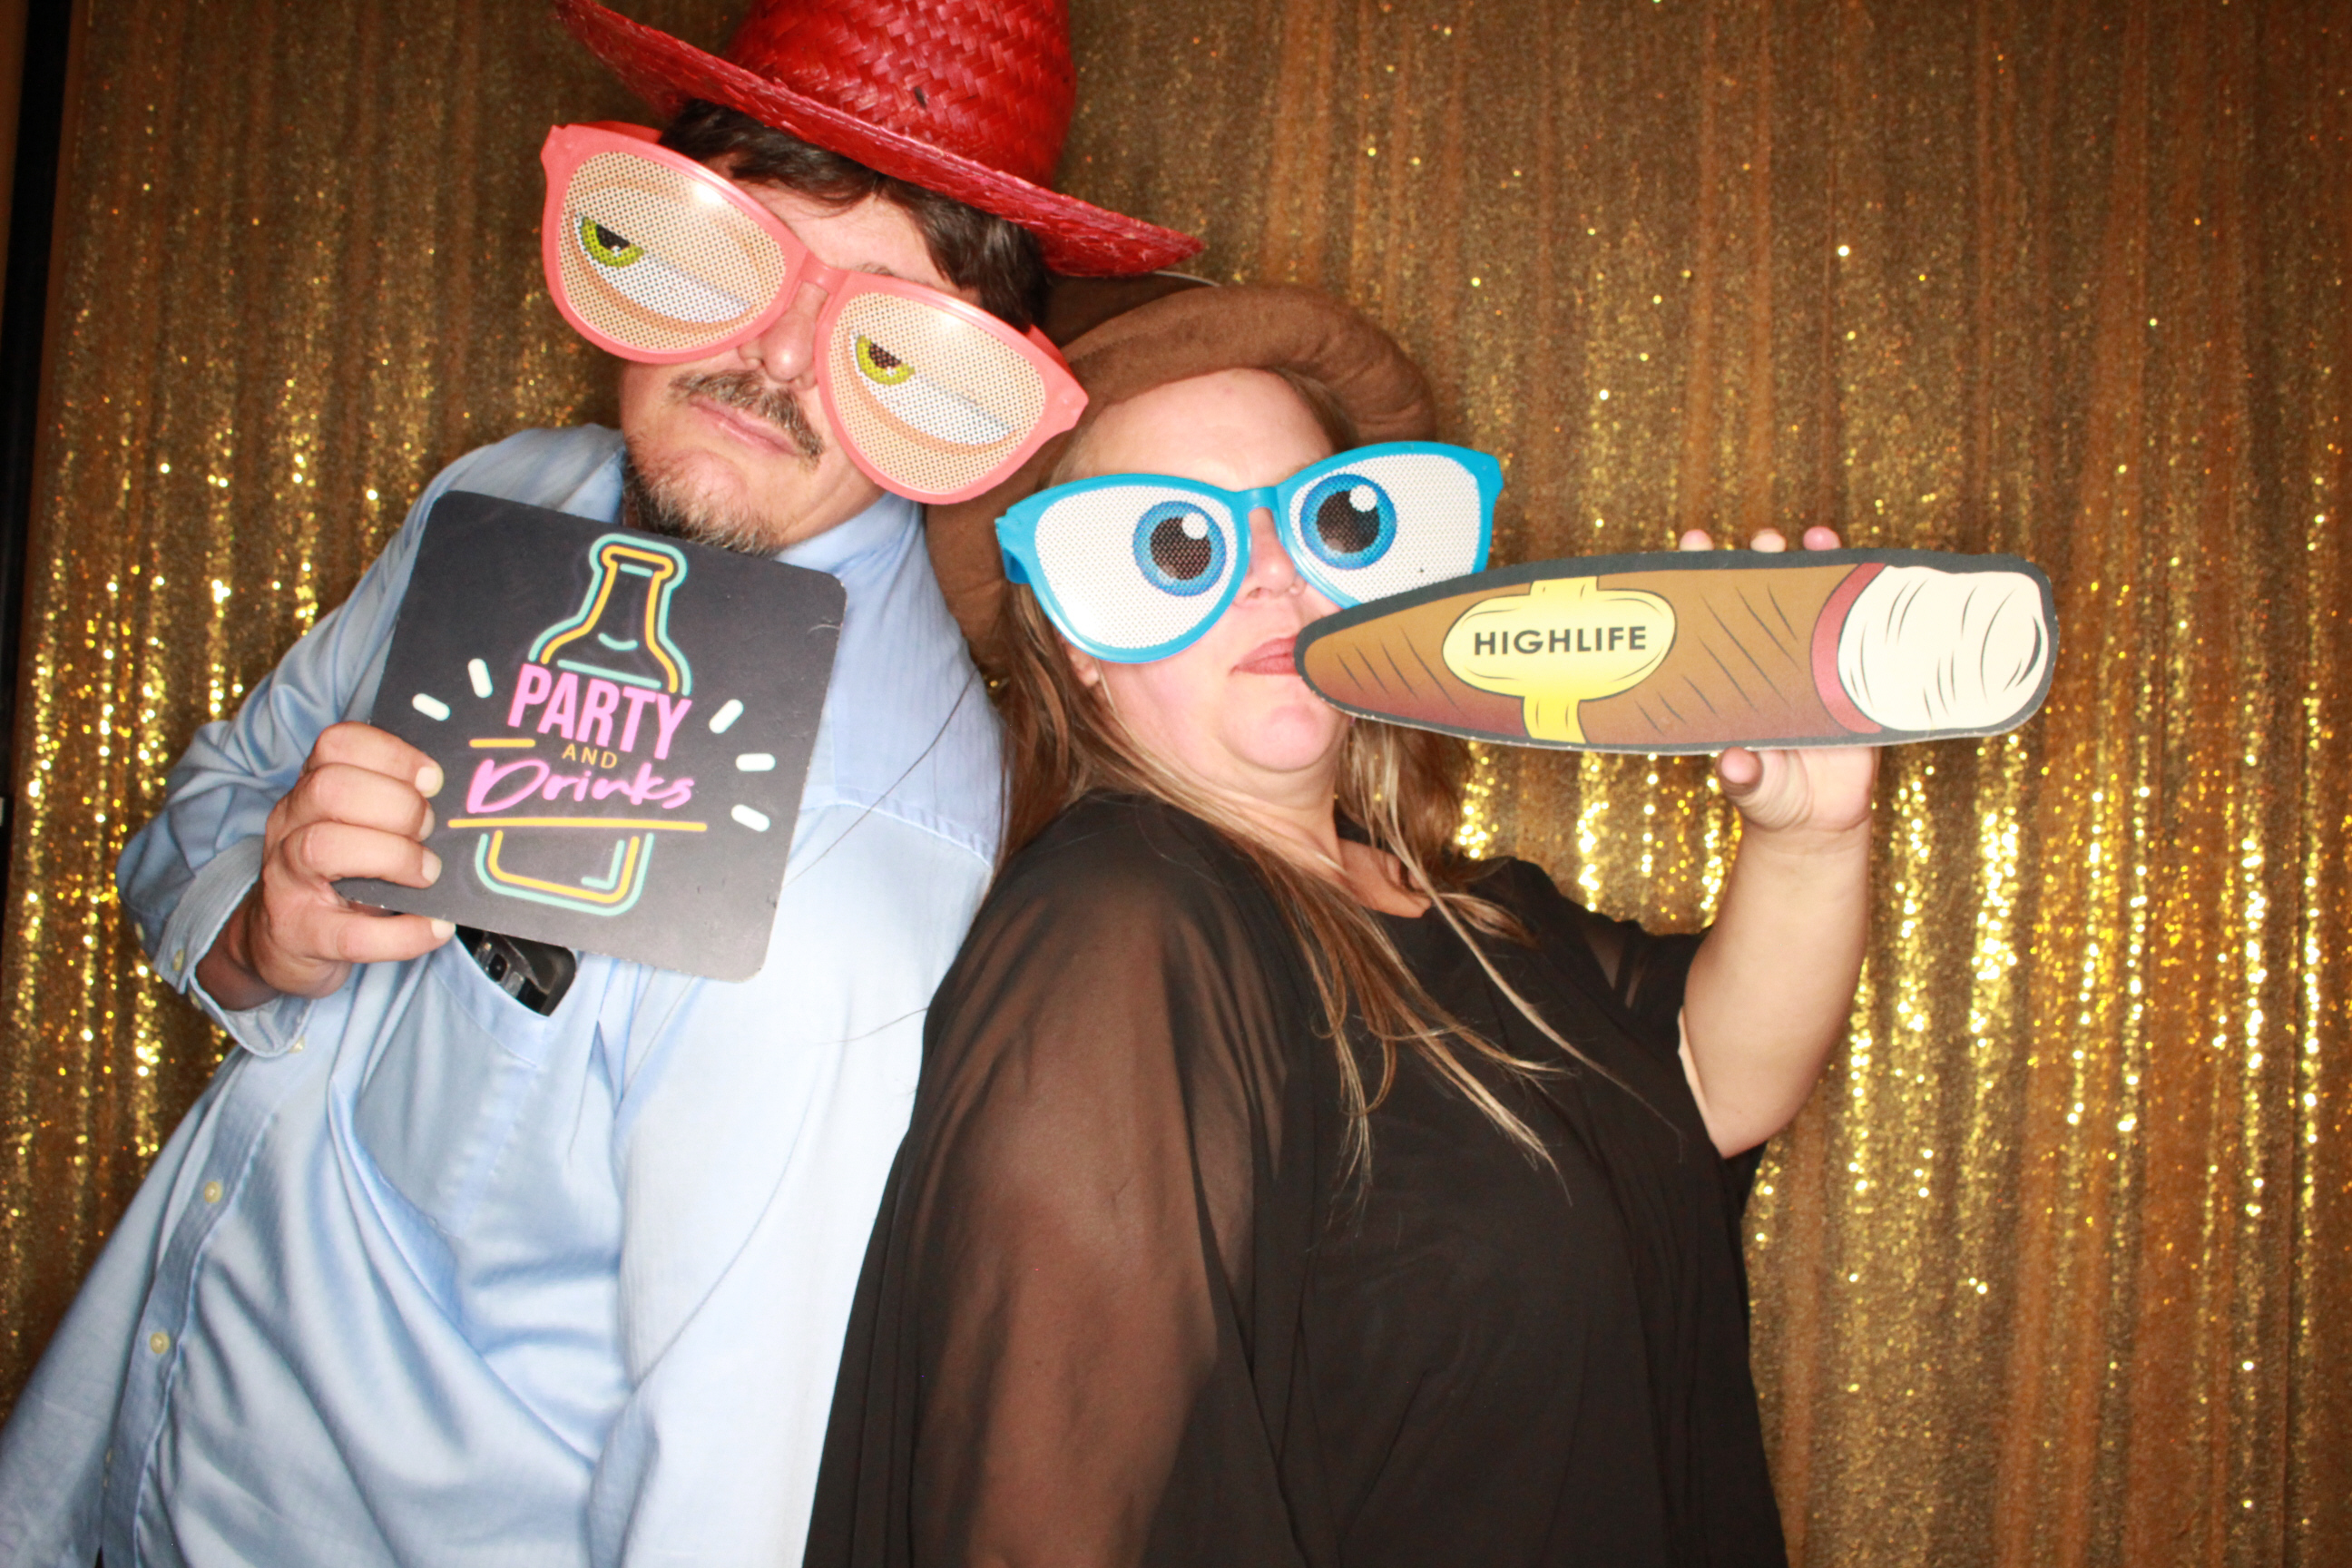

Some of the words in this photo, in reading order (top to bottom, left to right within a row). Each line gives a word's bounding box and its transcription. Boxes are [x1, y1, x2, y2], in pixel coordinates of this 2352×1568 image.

[1474, 625, 1647, 656] HIGHLIFE
[507, 662, 692, 760] PARTY
[562, 743, 618, 769] AND
[466, 759, 695, 814] Drinks
